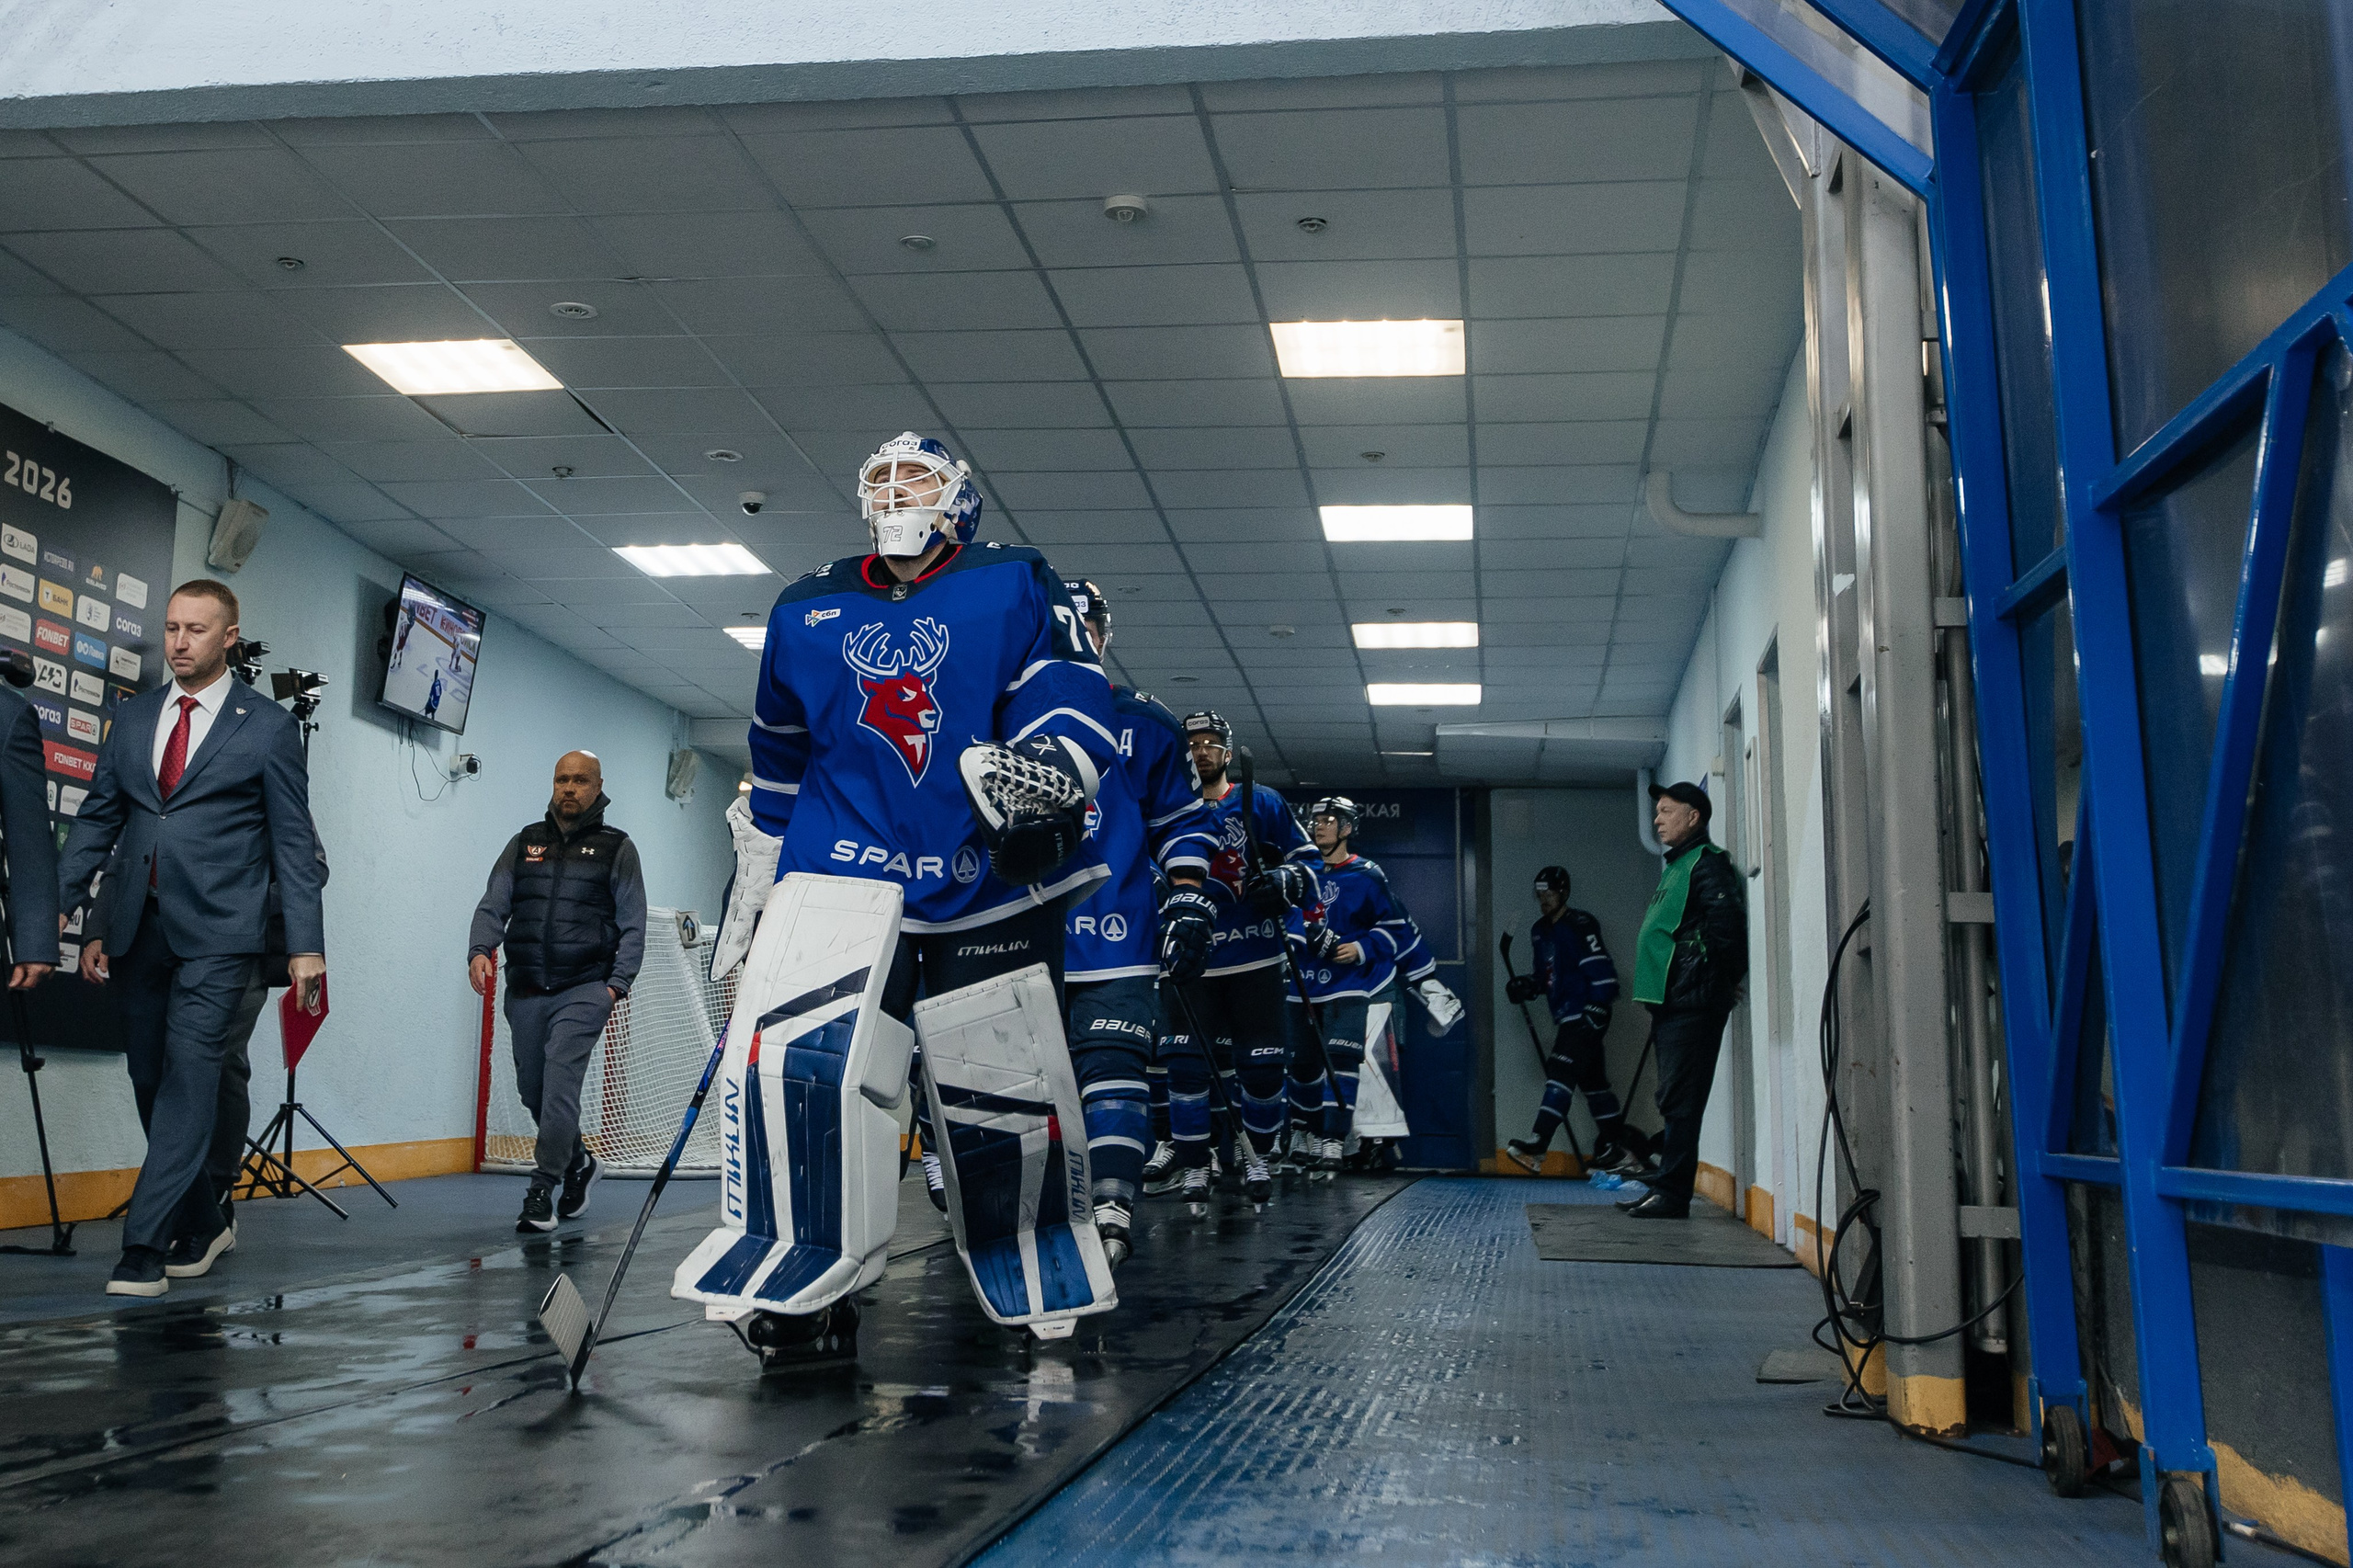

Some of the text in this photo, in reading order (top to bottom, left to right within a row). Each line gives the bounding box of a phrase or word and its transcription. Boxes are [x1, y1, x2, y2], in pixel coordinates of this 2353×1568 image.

[882, 439, 918, 449] согаз
[4, 449, 72, 509] 2026
[883, 525, 903, 543] 72
[19, 541, 35, 554] LADA
[52, 594, 69, 607] БАНК
[116, 617, 142, 637] согаз
[37, 626, 69, 648] FONBET
[70, 718, 91, 733] SPAR
[1119, 728, 1133, 756] A
[54, 752, 83, 768] FONBET
[830, 839, 944, 880] SPAR
[1206, 925, 1260, 947] PAR
[1586, 934, 1601, 952] 2
[1250, 1047, 1285, 1057] CCM
